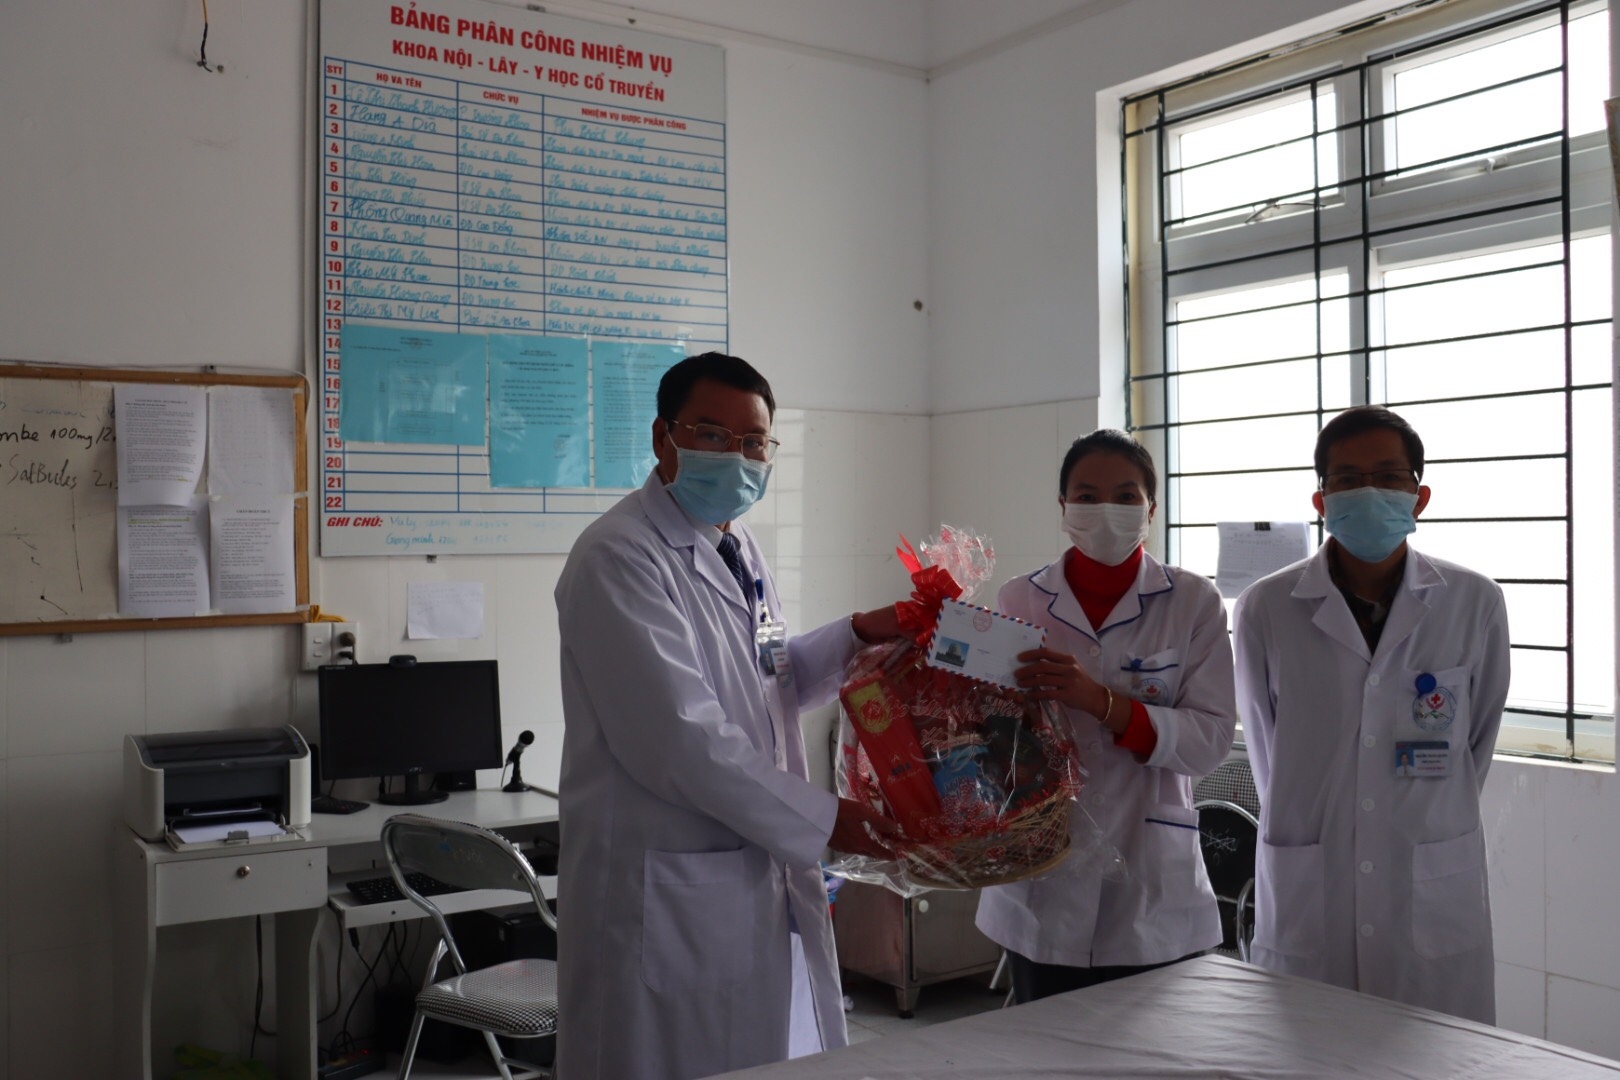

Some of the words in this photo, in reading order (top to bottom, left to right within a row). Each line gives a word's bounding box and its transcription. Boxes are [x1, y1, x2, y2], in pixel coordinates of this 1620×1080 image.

[388, 1, 452, 35] BẢNG
[455, 17, 515, 47] PHÂN
[519, 29, 577, 58] CÔNG
[580, 41, 645, 70] NHIỆM
[648, 53, 673, 77] VỤ
[327, 64, 343, 74] STT
[391, 39, 438, 61] KHOA
[442, 48, 474, 69] NỘI
[487, 56, 519, 76] LÂY
[533, 65, 545, 80] Y
[547, 67, 581, 88] HỌC
[583, 72, 605, 92] CỔ
[608, 74, 665, 103] TRUYỀN
[375, 72, 389, 84] HỌ
[405, 77, 423, 89] TÊN
[331, 83, 338, 94] 1
[482, 89, 506, 102] CHỨC
[507, 94, 520, 105] VỤ
[329, 102, 338, 116] 2
[580, 107, 607, 119] NHIỆM
[608, 112, 620, 122] VỤ
[620, 113, 642, 124] ĐƯỢC
[643, 117, 666, 127] PHÂN
[666, 120, 687, 130] CÔNG
[331, 121, 340, 135] 3
[331, 142, 340, 154] 4
[329, 161, 339, 173] 5
[329, 180, 340, 193] 6
[331, 200, 339, 212] 7
[329, 220, 340, 233] 8
[329, 239, 340, 253] 9
[327, 260, 343, 273] 10
[327, 278, 342, 291] 11
[326, 298, 342, 312] 12
[327, 318, 341, 330] 13
[327, 337, 339, 349] 14
[327, 358, 339, 370] 15
[327, 377, 339, 389] 16
[326, 396, 339, 408] 17
[327, 417, 338, 429] 18
[326, 437, 342, 449] 19
[326, 456, 342, 469] 20
[327, 476, 342, 489] 21
[326, 495, 342, 509] 22
[326, 516, 351, 528] GHI
